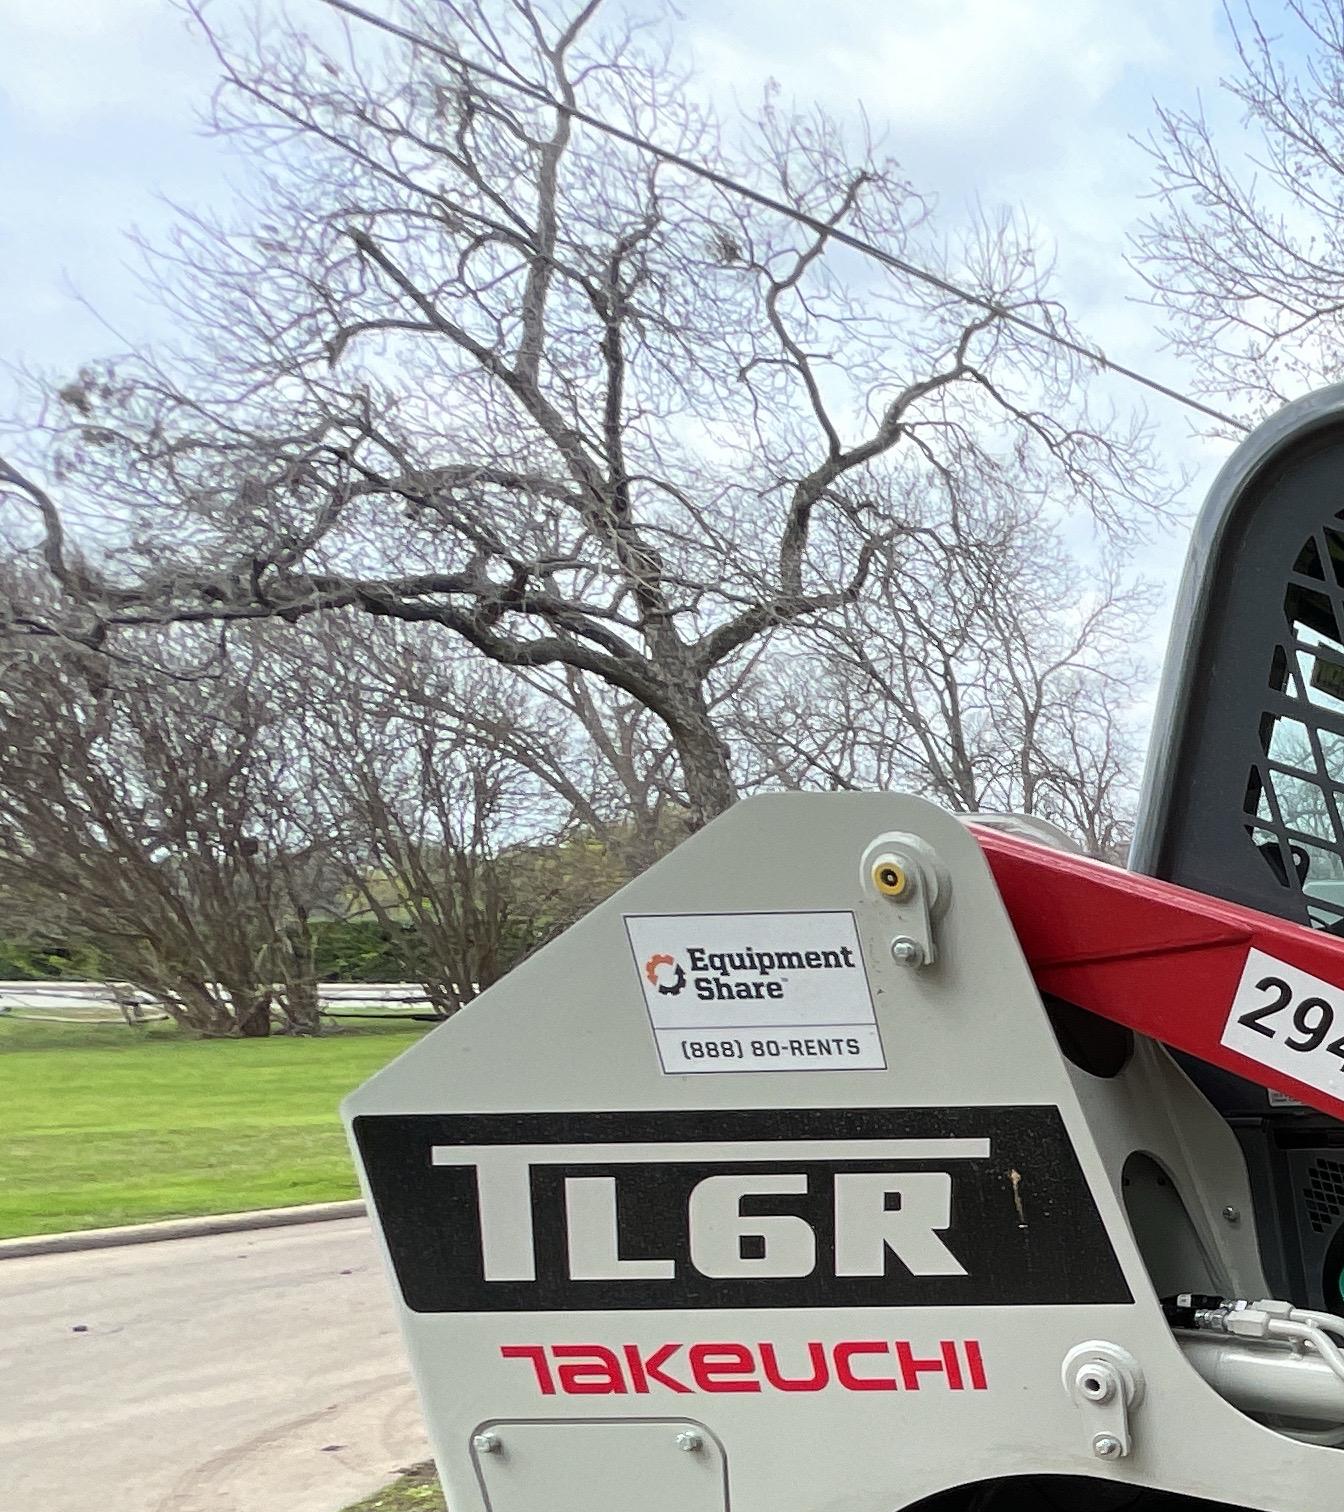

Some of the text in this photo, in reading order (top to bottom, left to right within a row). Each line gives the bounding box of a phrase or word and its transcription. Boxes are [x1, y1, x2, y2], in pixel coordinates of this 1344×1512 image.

[686, 946, 856, 976] Equipment
[694, 977, 784, 1001] Share
[681, 1037, 861, 1060] (888) 80-RENTS
[430, 1137, 991, 1283] TL6R
